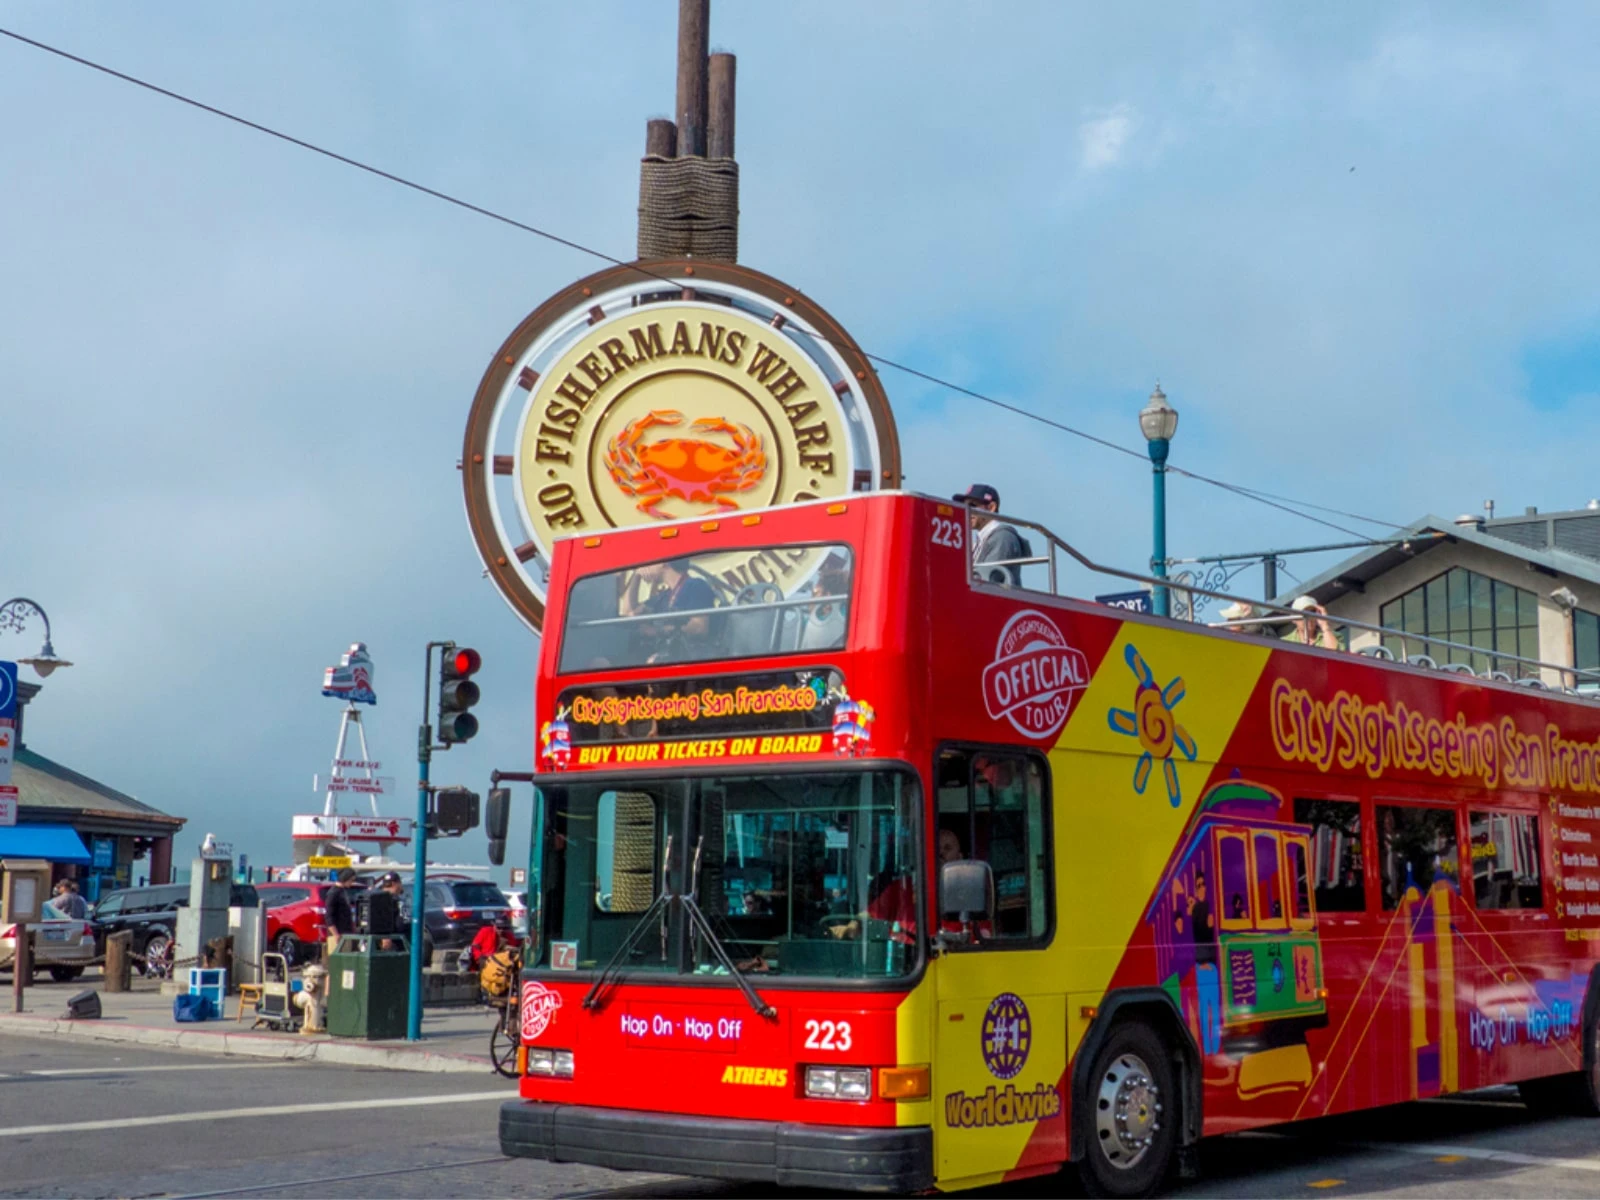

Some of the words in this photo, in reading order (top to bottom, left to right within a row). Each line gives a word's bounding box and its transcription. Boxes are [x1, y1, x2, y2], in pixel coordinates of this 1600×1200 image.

[535, 321, 748, 465] FISHERMANS
[744, 341, 836, 478] WHARF
[538, 483, 585, 527] OF
[931, 517, 963, 549] 223
[994, 655, 1085, 706] OFFICIAL
[572, 692, 699, 725] CitySightseeing
[701, 690, 733, 717] San
[736, 686, 817, 713] Francisco
[1025, 696, 1065, 729] TOUR
[578, 745, 614, 764] BUY
[616, 742, 659, 762] YOUR
[662, 739, 727, 760] TICKETS
[729, 738, 757, 756] ON
[759, 735, 823, 755] BOARD
[1270, 678, 1499, 789] CitySightseeing
[1502, 715, 1546, 788] San
[558, 947, 569, 965] 7
[620, 1014, 648, 1037] Hop
[652, 1014, 673, 1035] On
[685, 1017, 713, 1040] Hop
[717, 1018, 742, 1039] Off
[804, 1019, 852, 1051] 223
[992, 1016, 1020, 1054] #1
[1469, 1010, 1496, 1052] Hop
[1500, 1005, 1517, 1045] On
[1526, 1006, 1549, 1046] Hop
[1552, 1000, 1572, 1038] Off
[721, 1065, 788, 1087] ATHENS
[945, 1082, 1061, 1128] Worldwide
